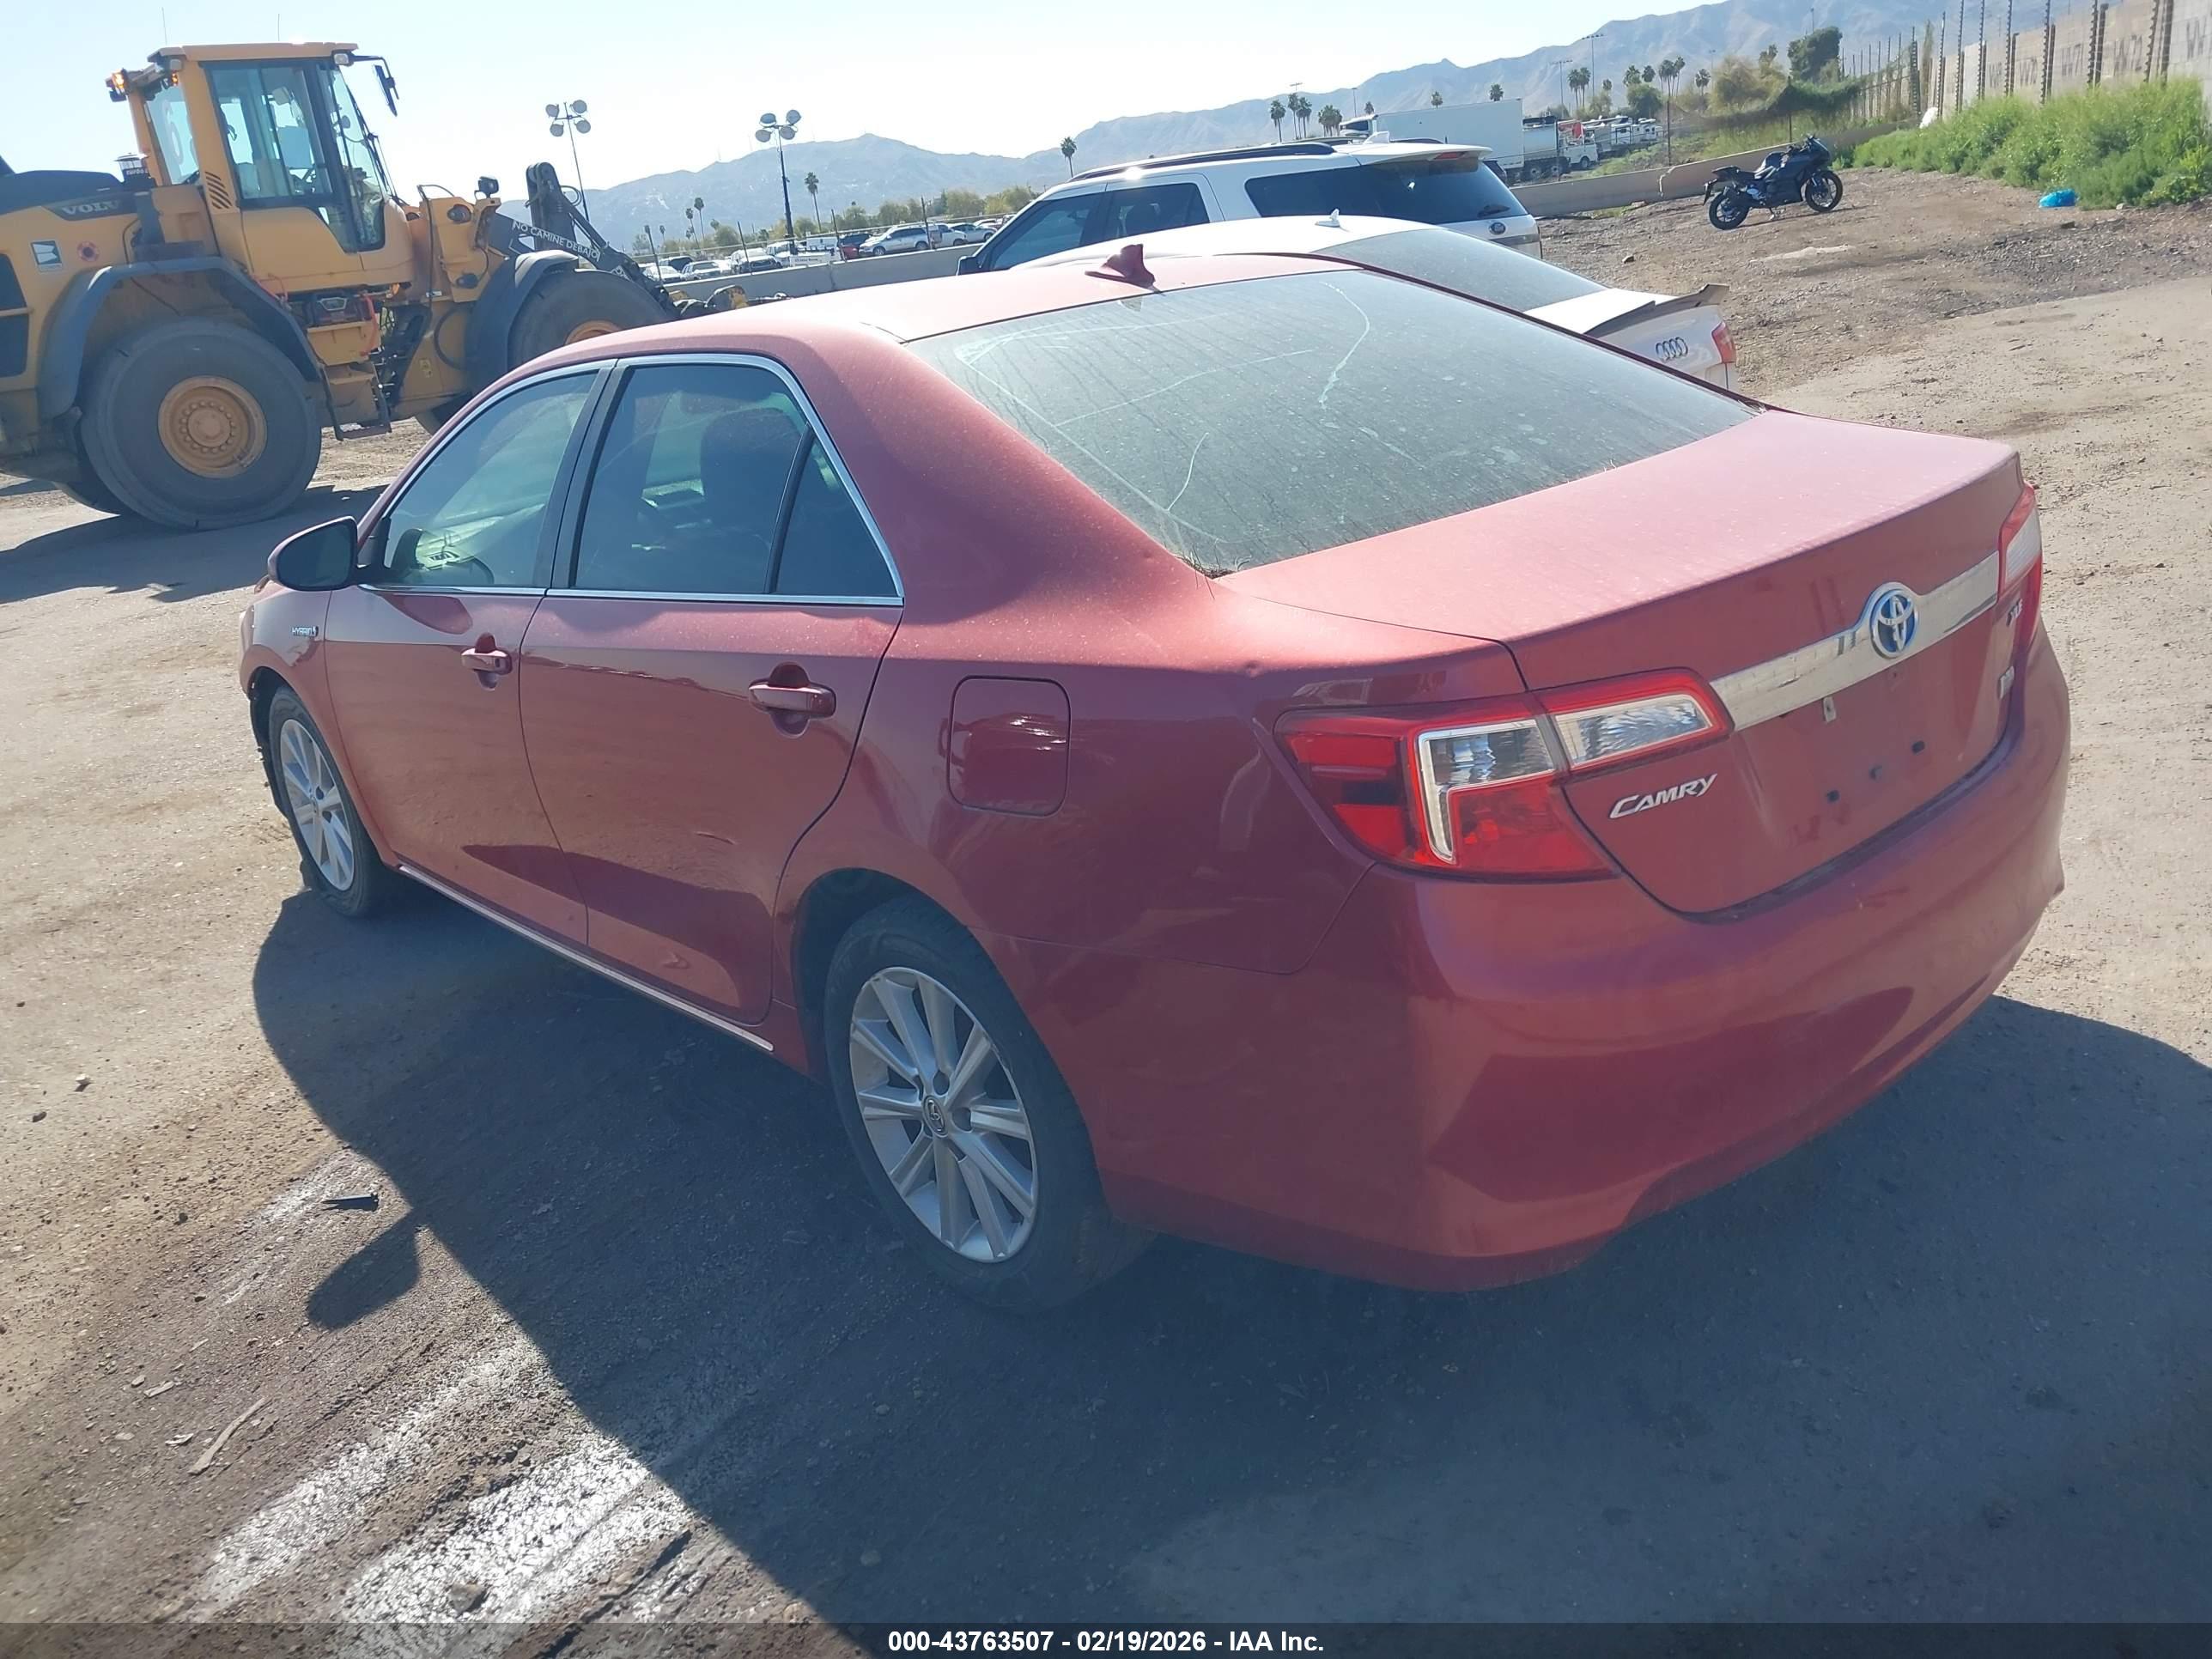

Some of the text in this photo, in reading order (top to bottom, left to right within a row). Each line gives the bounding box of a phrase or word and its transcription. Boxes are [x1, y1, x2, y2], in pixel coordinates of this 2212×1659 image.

[62, 200, 119, 215] VOLV
[513, 221, 599, 258] NO CAMINE DEBAJO
[1609, 773, 1718, 819] CAMRY
